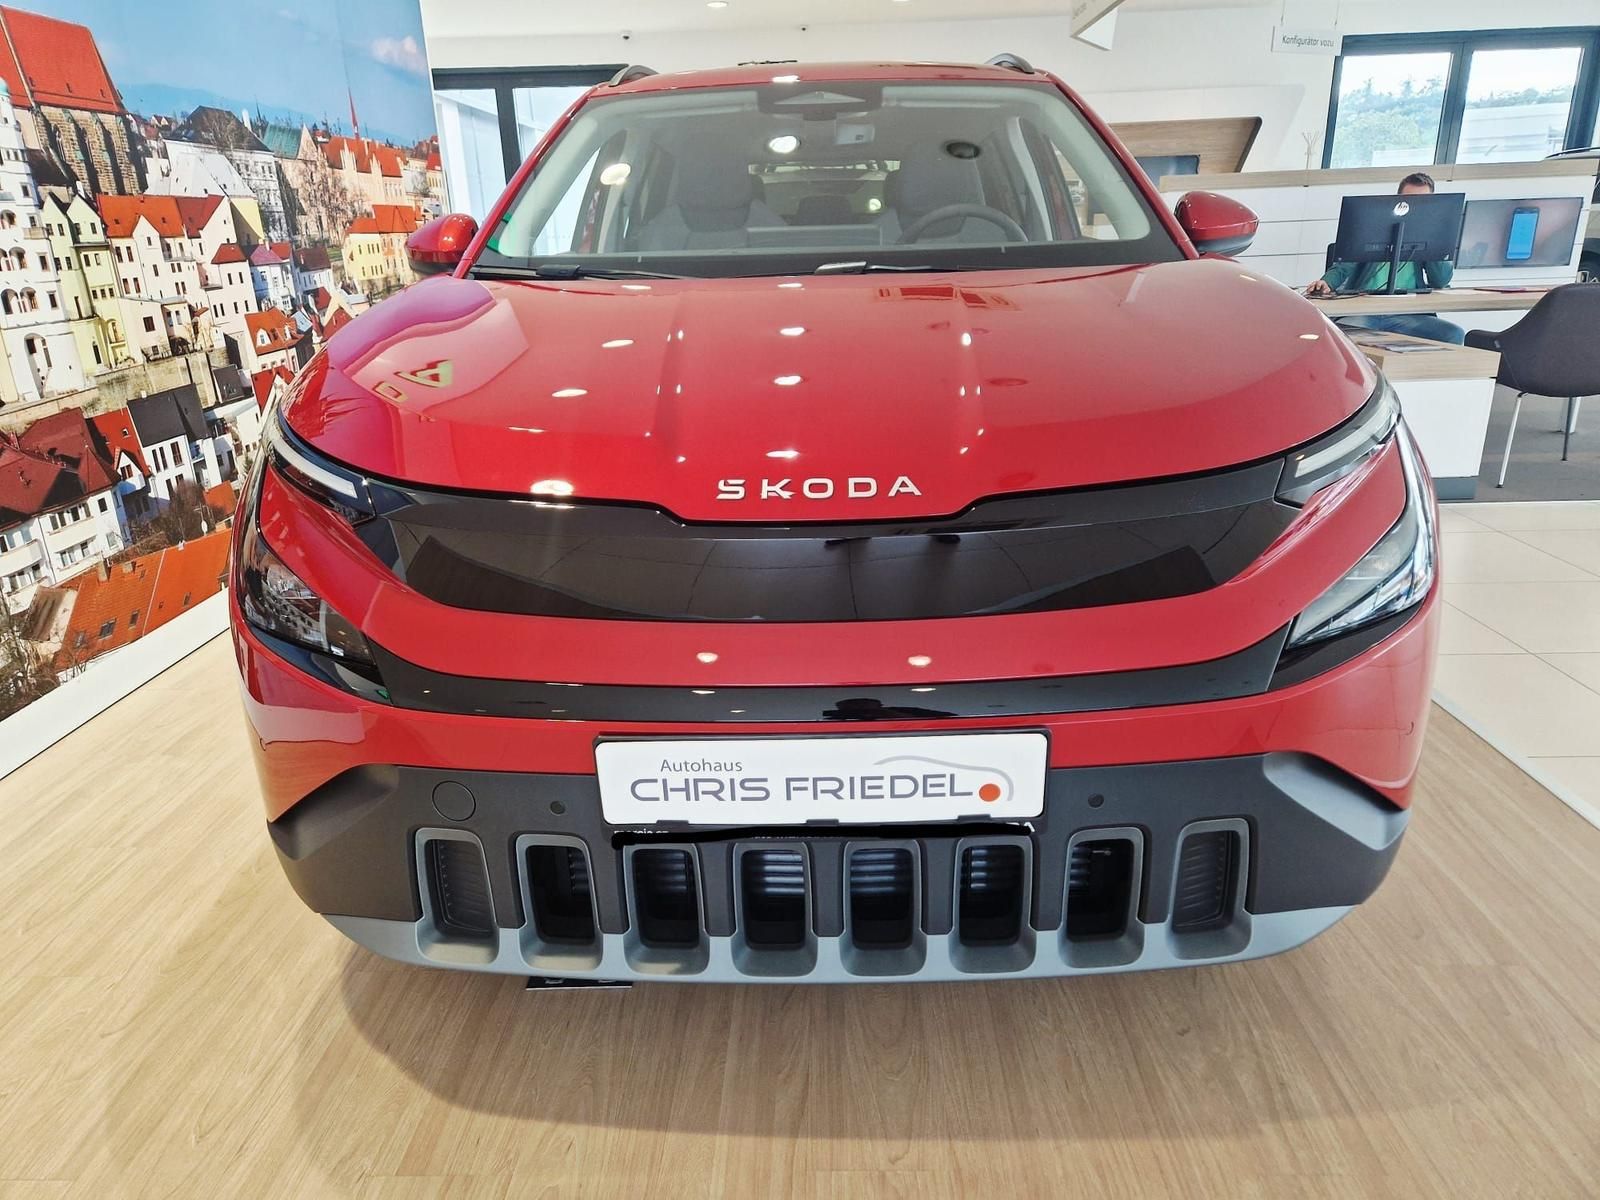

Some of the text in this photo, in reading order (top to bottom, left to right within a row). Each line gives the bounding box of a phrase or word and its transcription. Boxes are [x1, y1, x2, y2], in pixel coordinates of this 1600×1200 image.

[1320, 39, 1335, 47] vozu
[660, 758, 743, 772] Autohaus
[630, 773, 974, 802] CHRIS FRIEDEL
